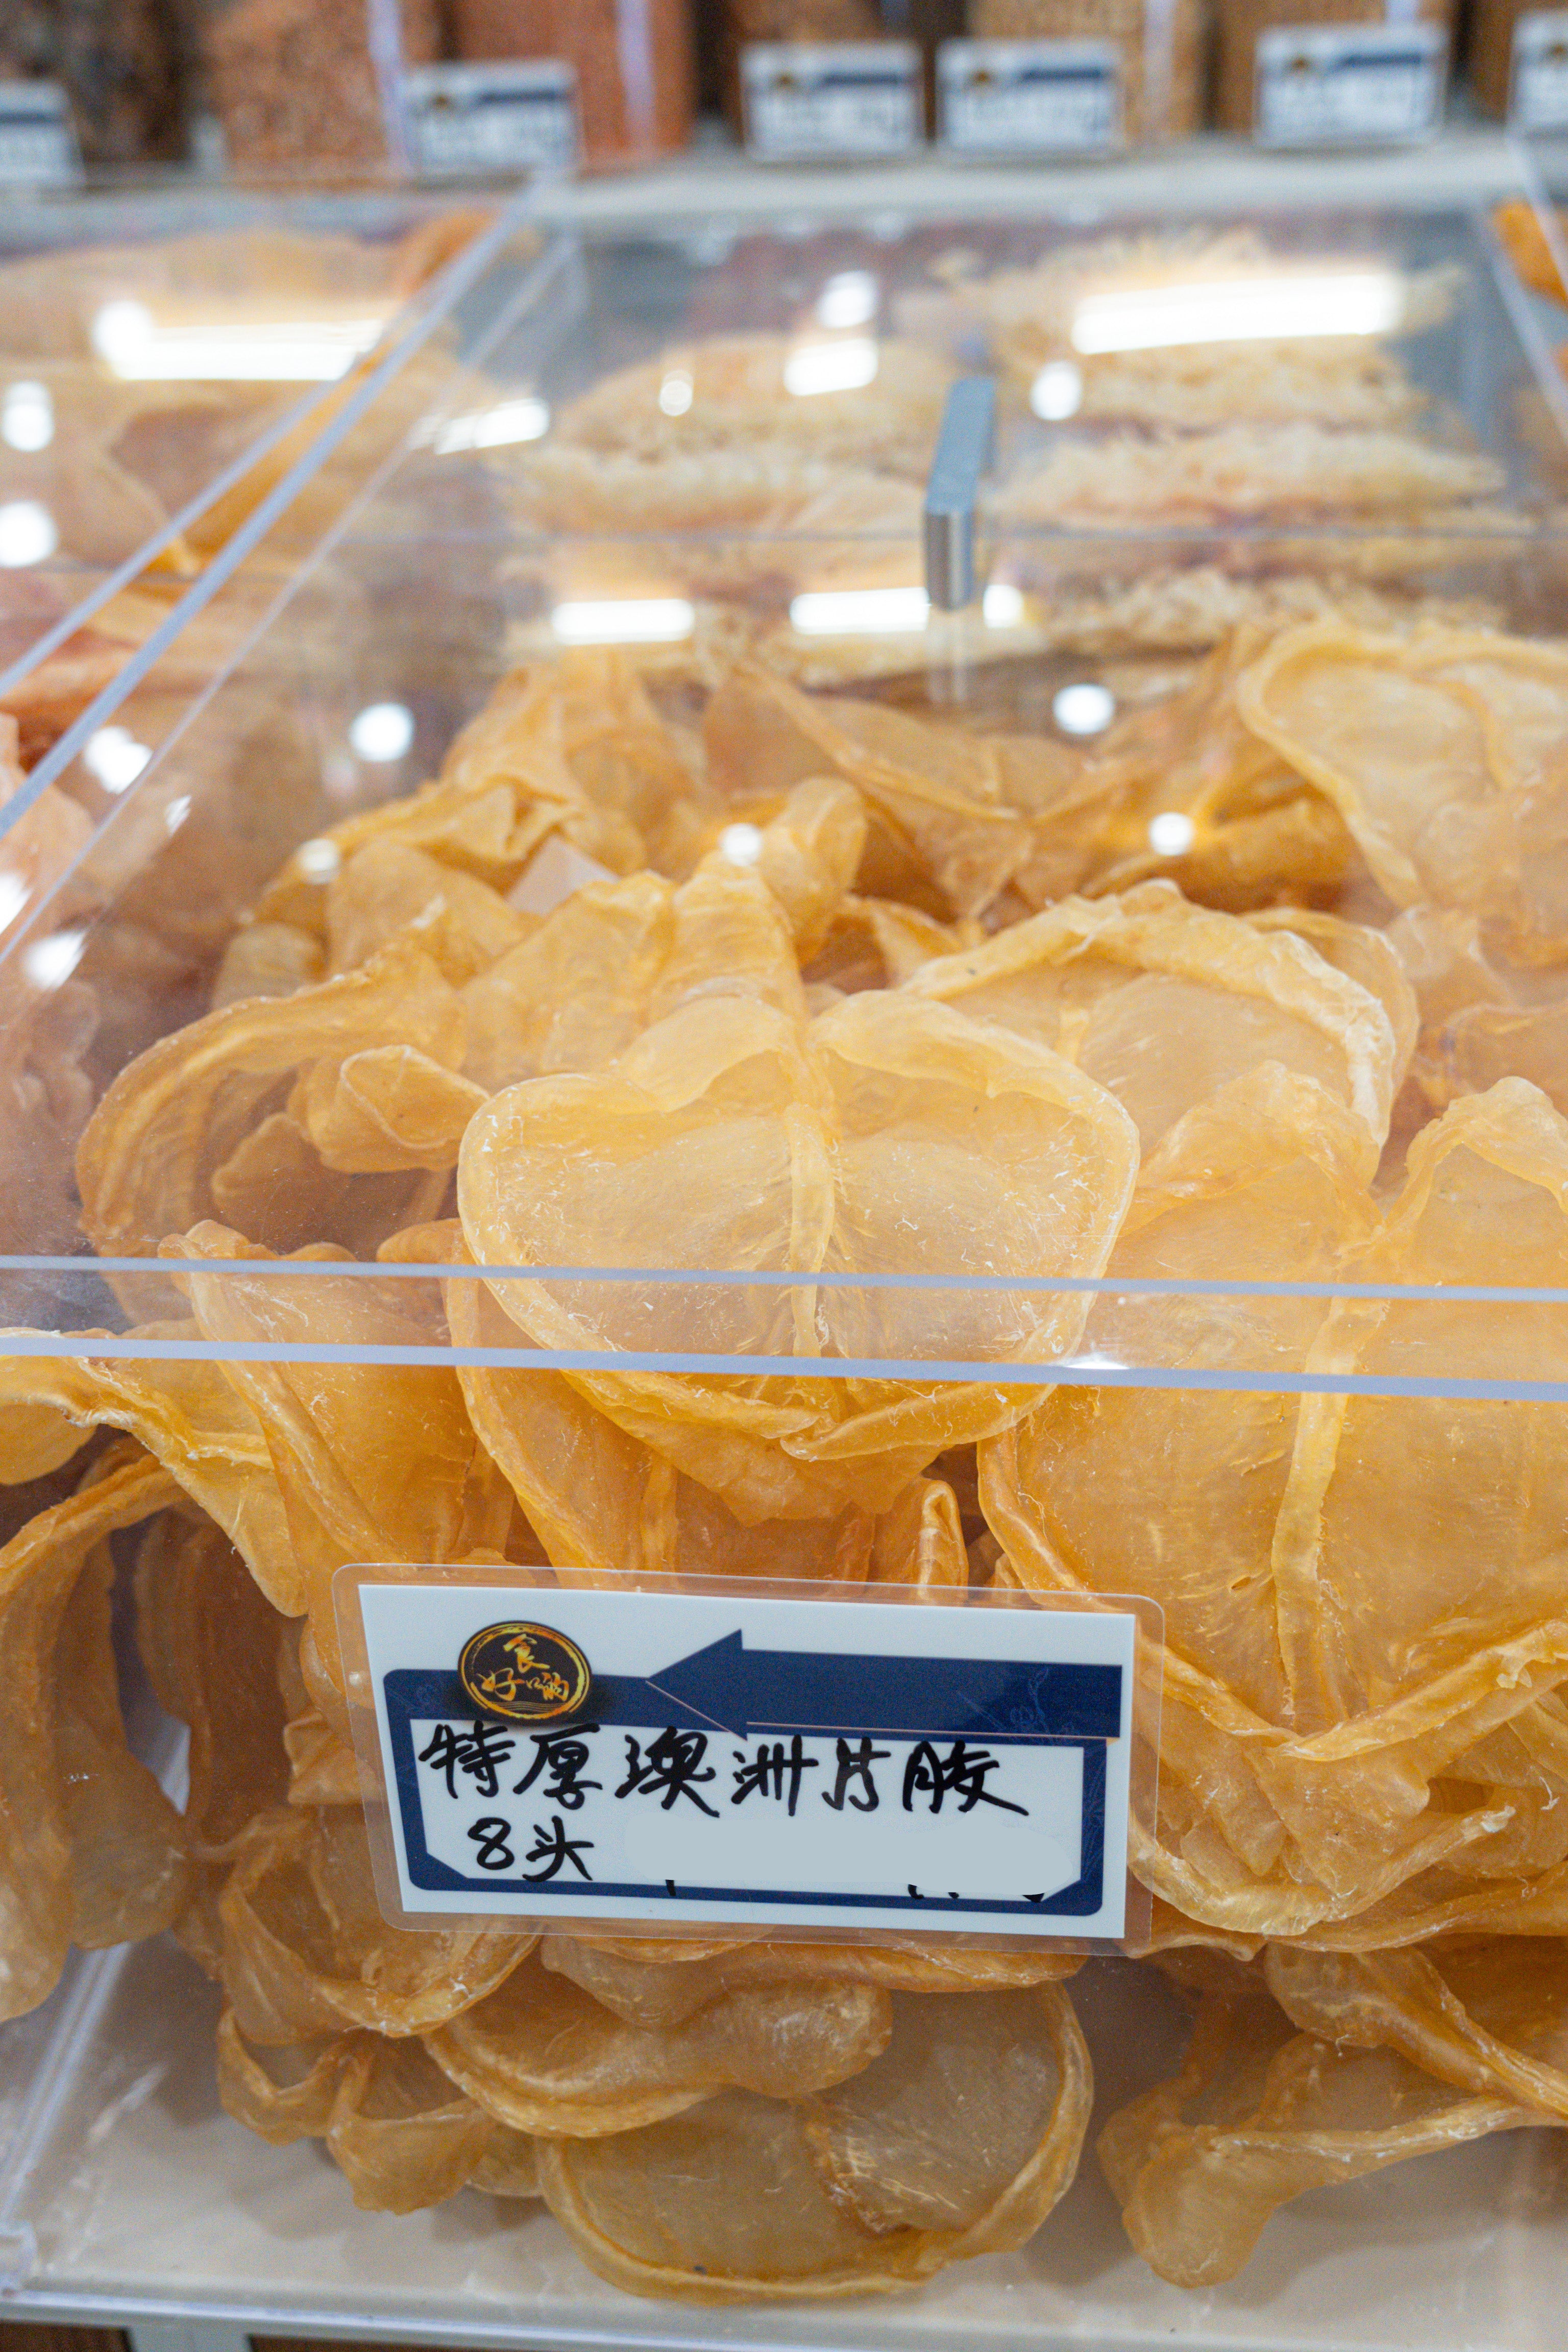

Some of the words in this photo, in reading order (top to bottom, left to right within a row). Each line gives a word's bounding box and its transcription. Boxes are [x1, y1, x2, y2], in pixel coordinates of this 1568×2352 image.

[419, 1721, 1028, 1817] 特厚澳洲片胶
[468, 1816, 594, 1884] 8头
